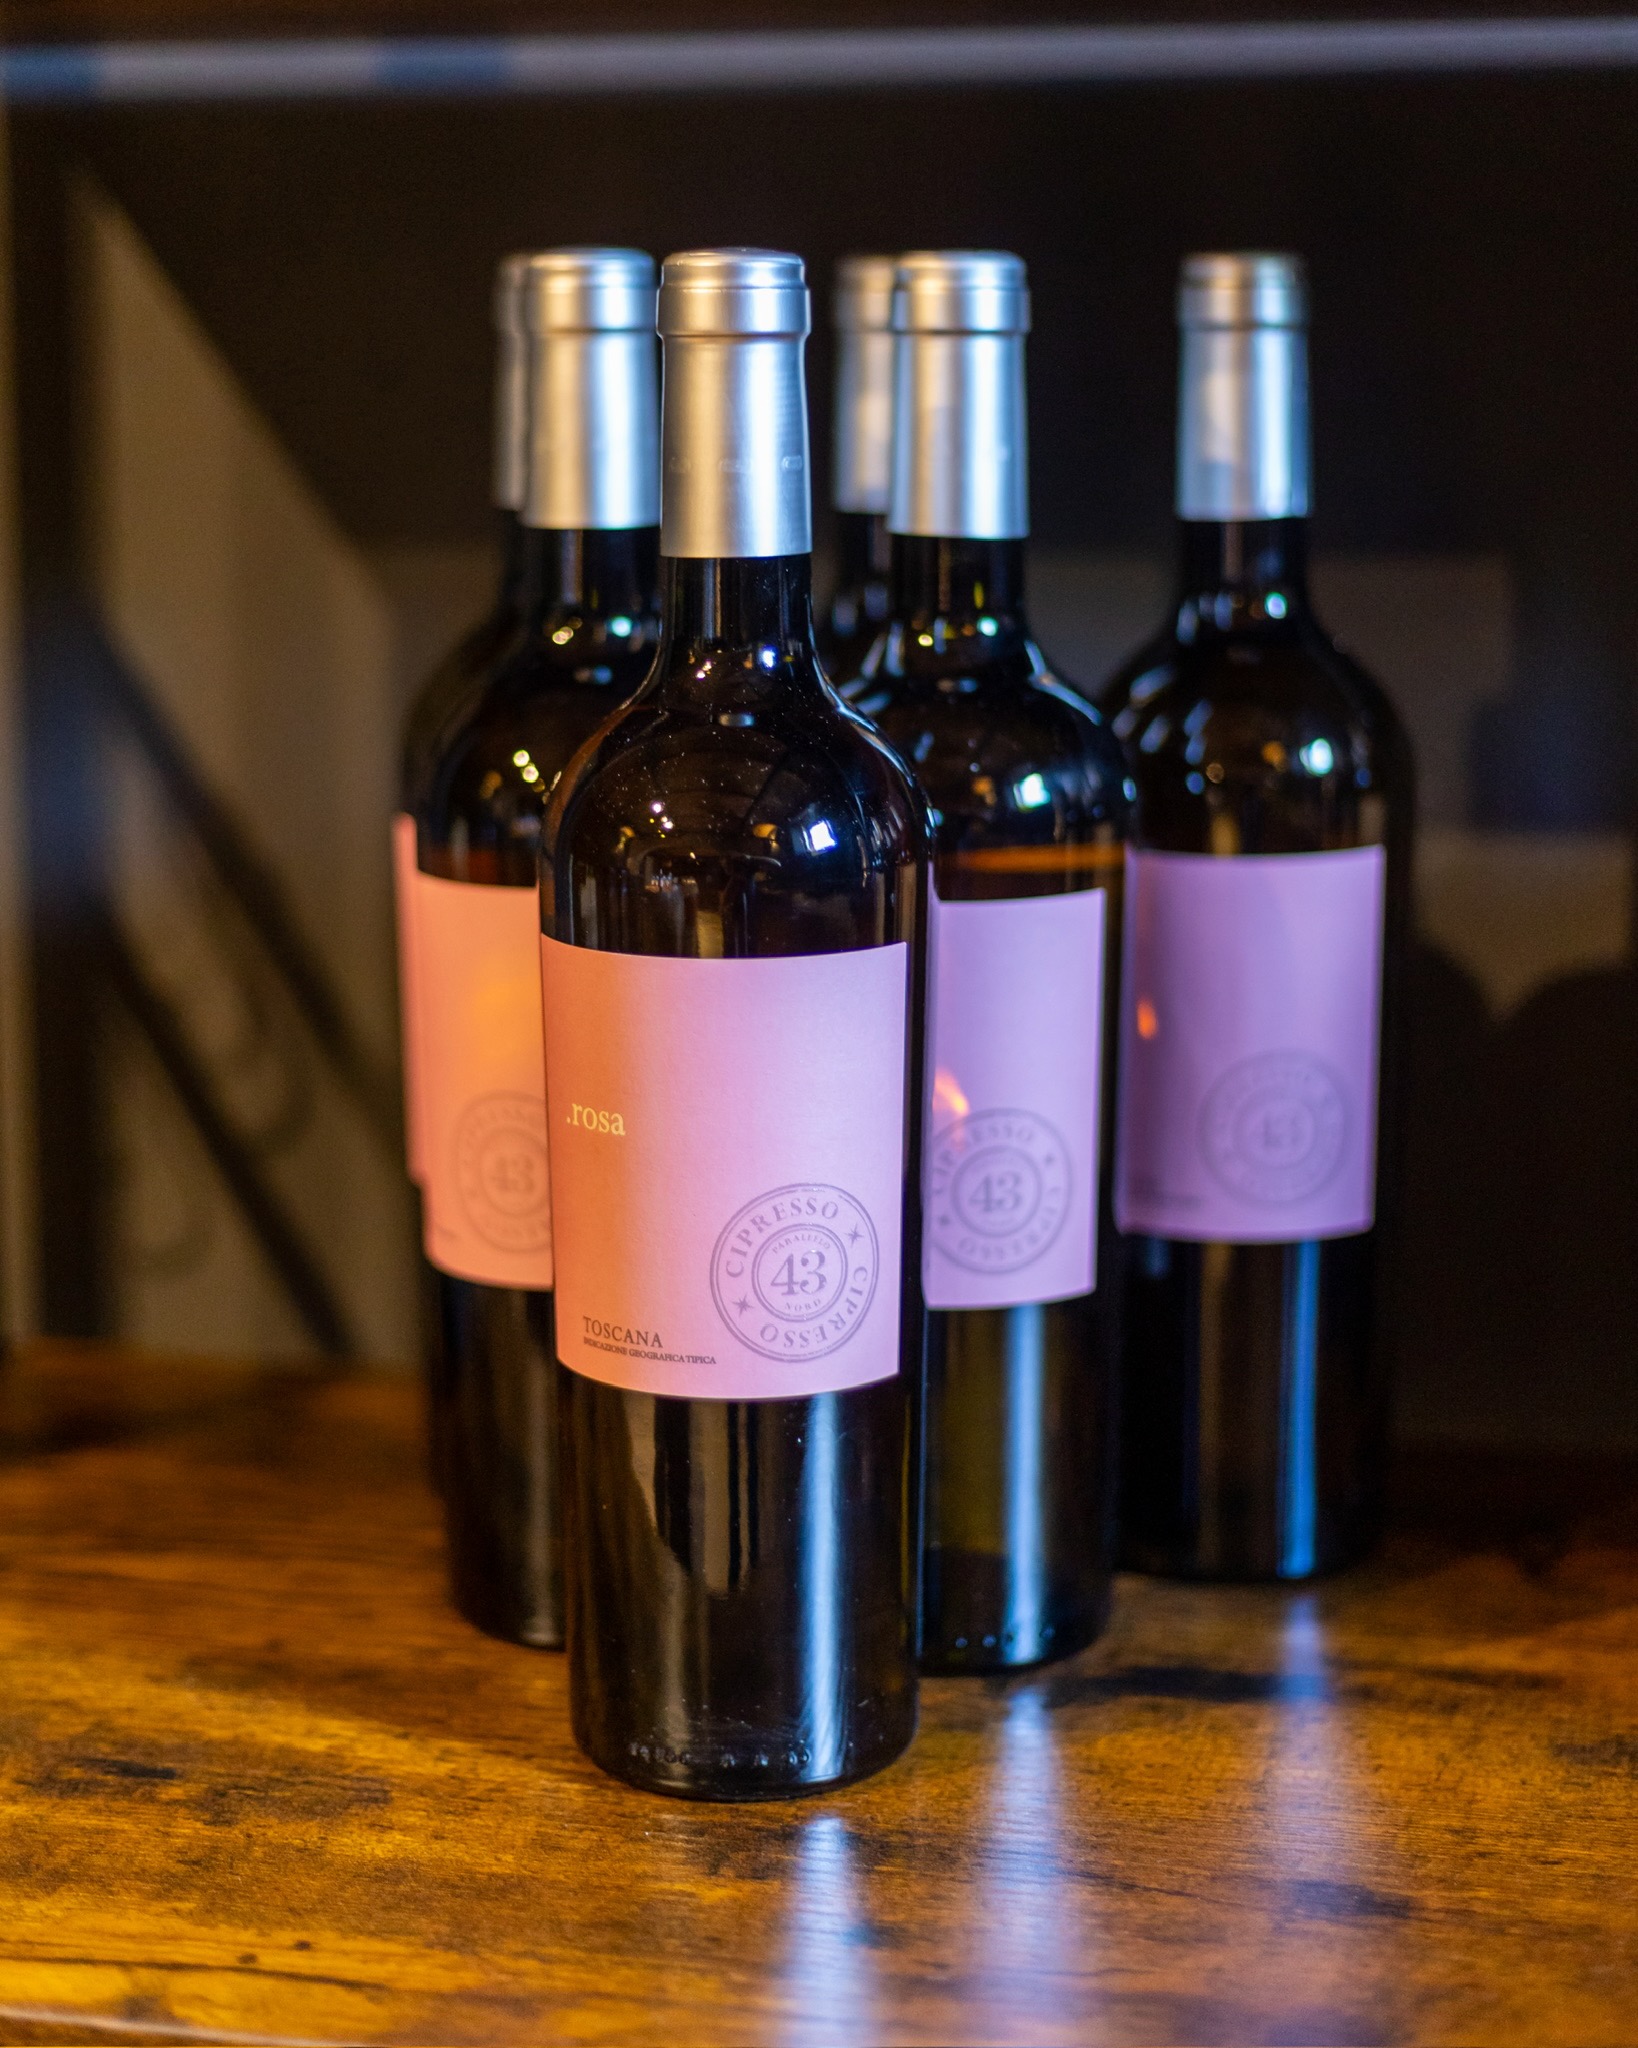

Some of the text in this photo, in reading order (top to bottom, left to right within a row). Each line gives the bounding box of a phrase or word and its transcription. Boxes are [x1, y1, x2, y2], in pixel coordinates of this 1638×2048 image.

[566, 1102, 626, 1136] .rosa
[968, 1171, 1023, 1213] 43
[726, 1197, 839, 1278] CIPRESSO
[770, 1251, 827, 1297] 43
[760, 1266, 868, 1349] CIPRESSO
[583, 1316, 663, 1348] TOSCANA
[686, 1355, 717, 1364] TIPICA
